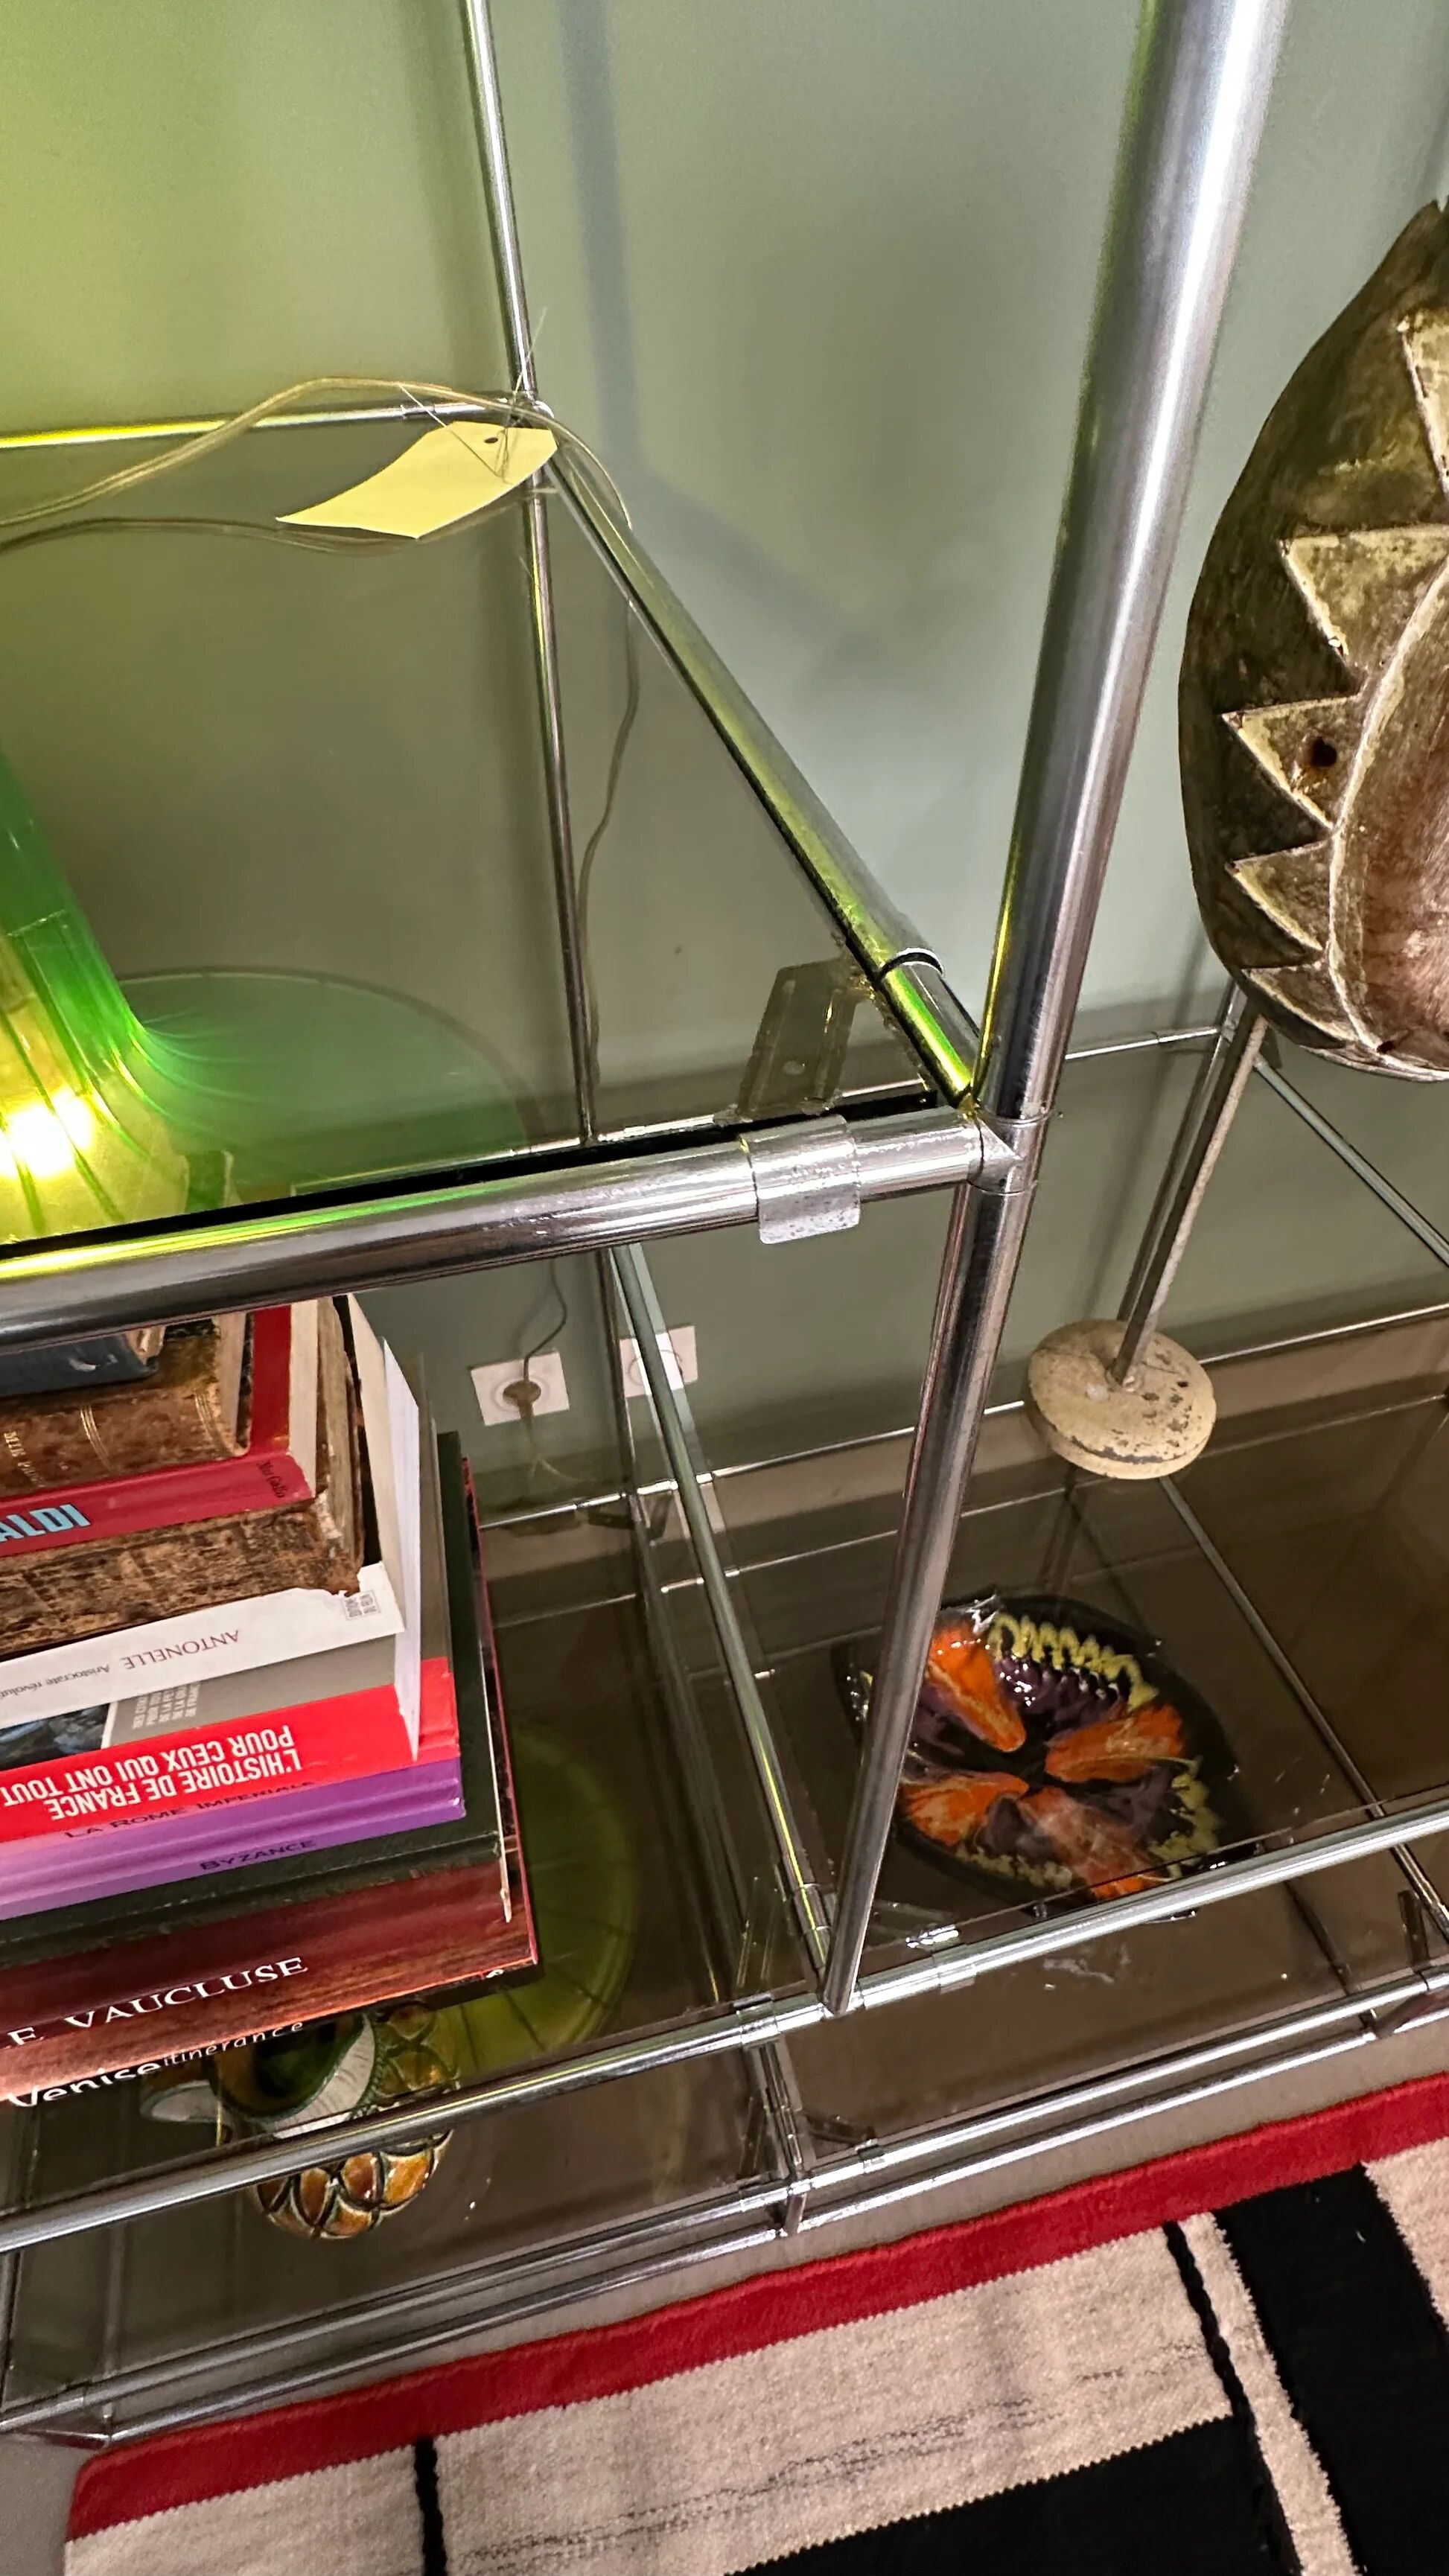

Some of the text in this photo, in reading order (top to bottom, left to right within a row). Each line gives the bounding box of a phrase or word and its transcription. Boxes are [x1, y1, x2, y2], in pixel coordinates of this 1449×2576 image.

[0, 1503, 91, 1543] ALDI
[121, 1630, 240, 1669] ANTONELLE
[45, 1665, 110, 1686] Aristocrate
[0, 1724, 295, 1807] POUR CEUX QUI ONT TOUT
[44, 1748, 302, 1820] L'HISTOIRE DE FRANCE
[64, 1827, 103, 1839] LA
[109, 1806, 186, 1829] ROME
[200, 1840, 316, 1872] BYZANCE
[64, 1957, 308, 2029] VAUCLUSE
